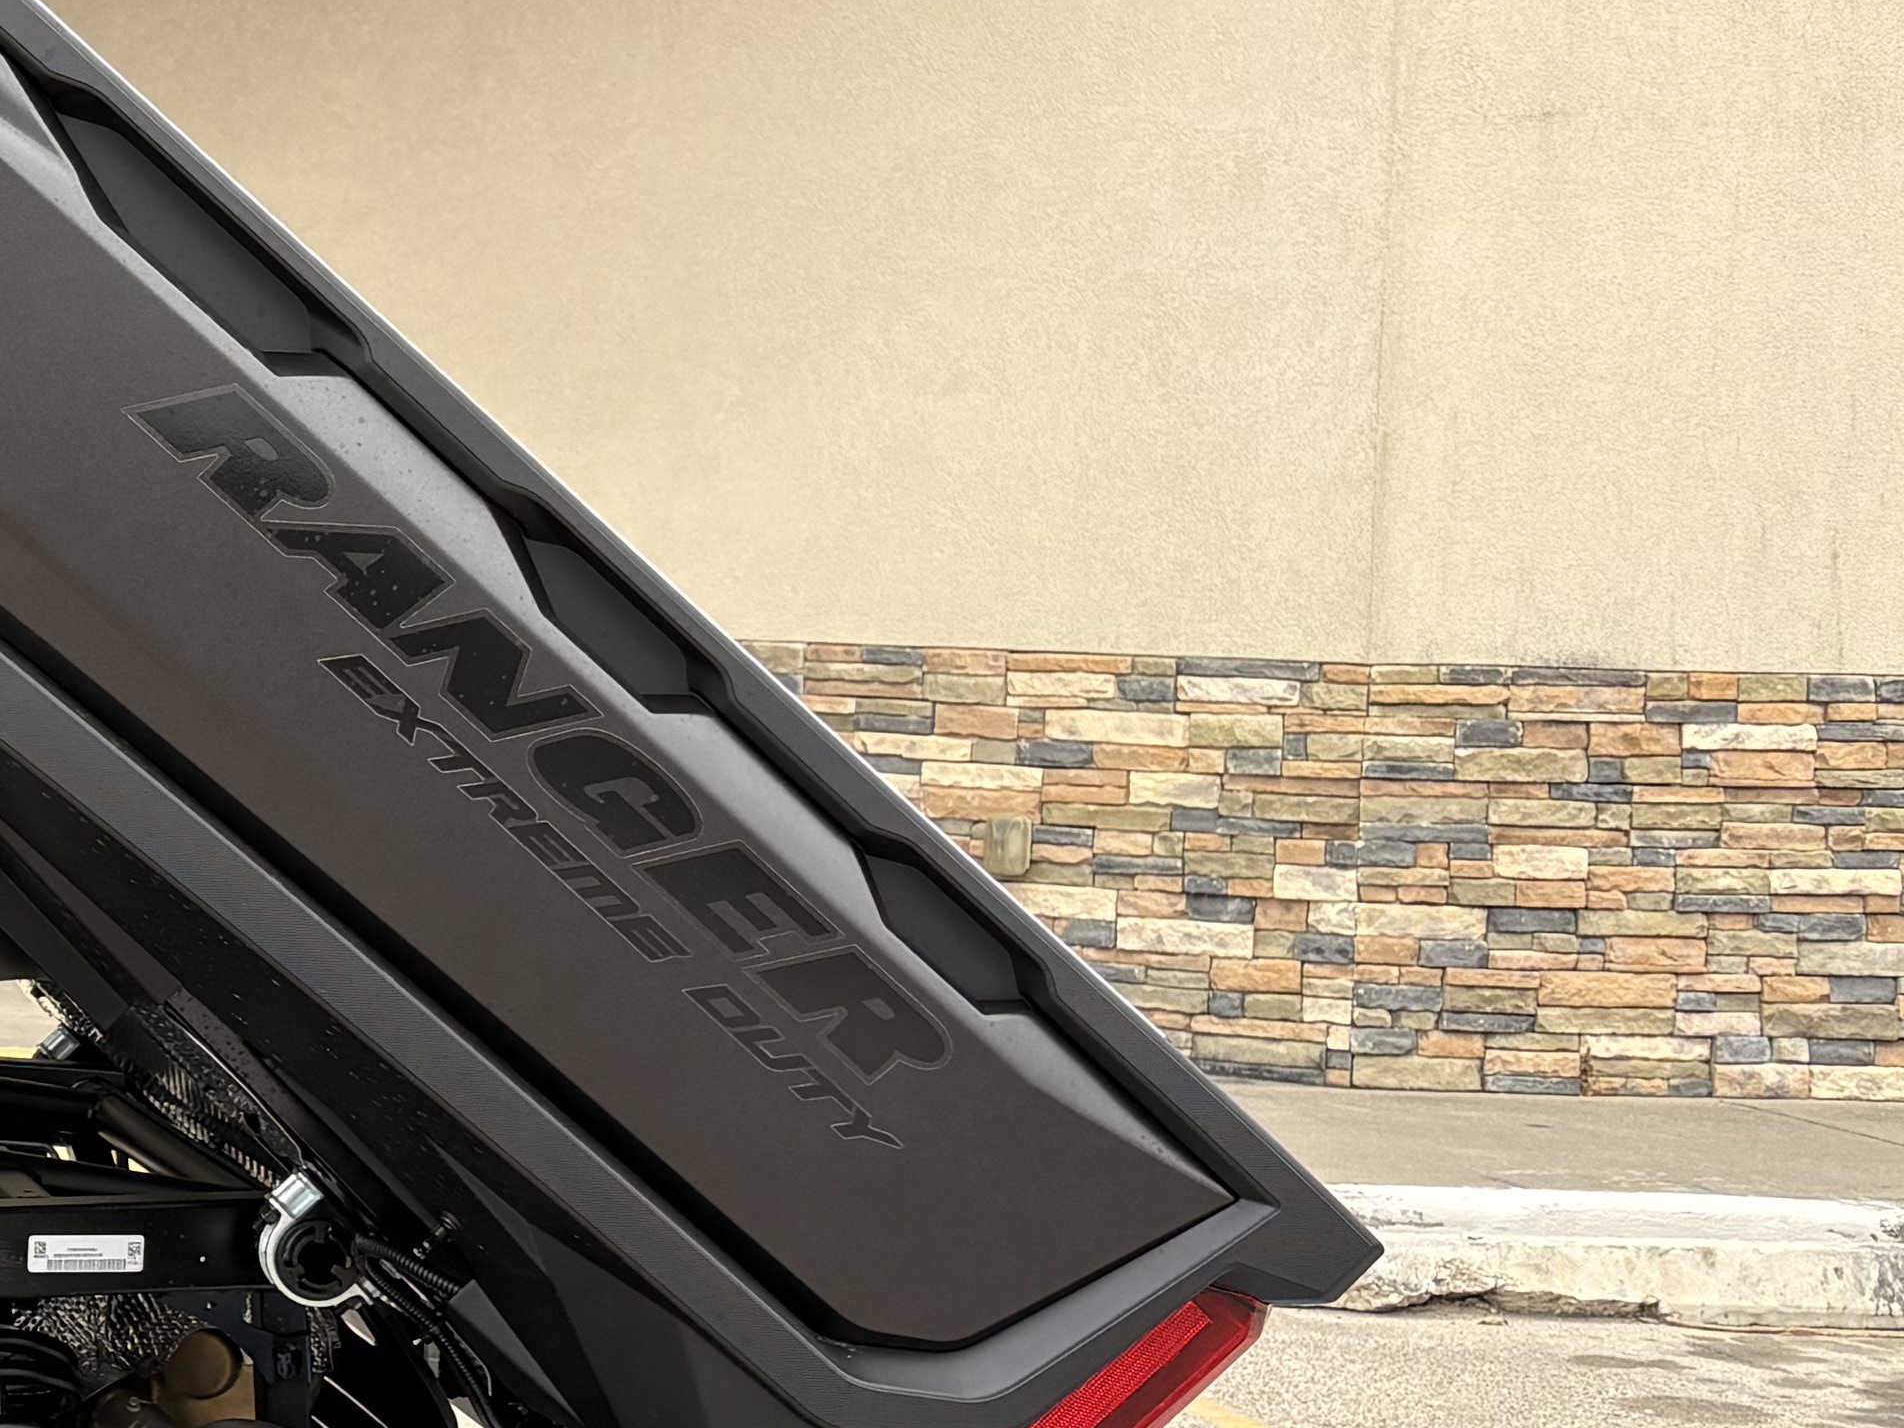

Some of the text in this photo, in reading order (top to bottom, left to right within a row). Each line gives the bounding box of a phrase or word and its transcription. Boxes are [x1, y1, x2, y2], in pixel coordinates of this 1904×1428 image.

[119, 383, 954, 1085] RANGER
[317, 654, 906, 1150] EXTREME DUTY
